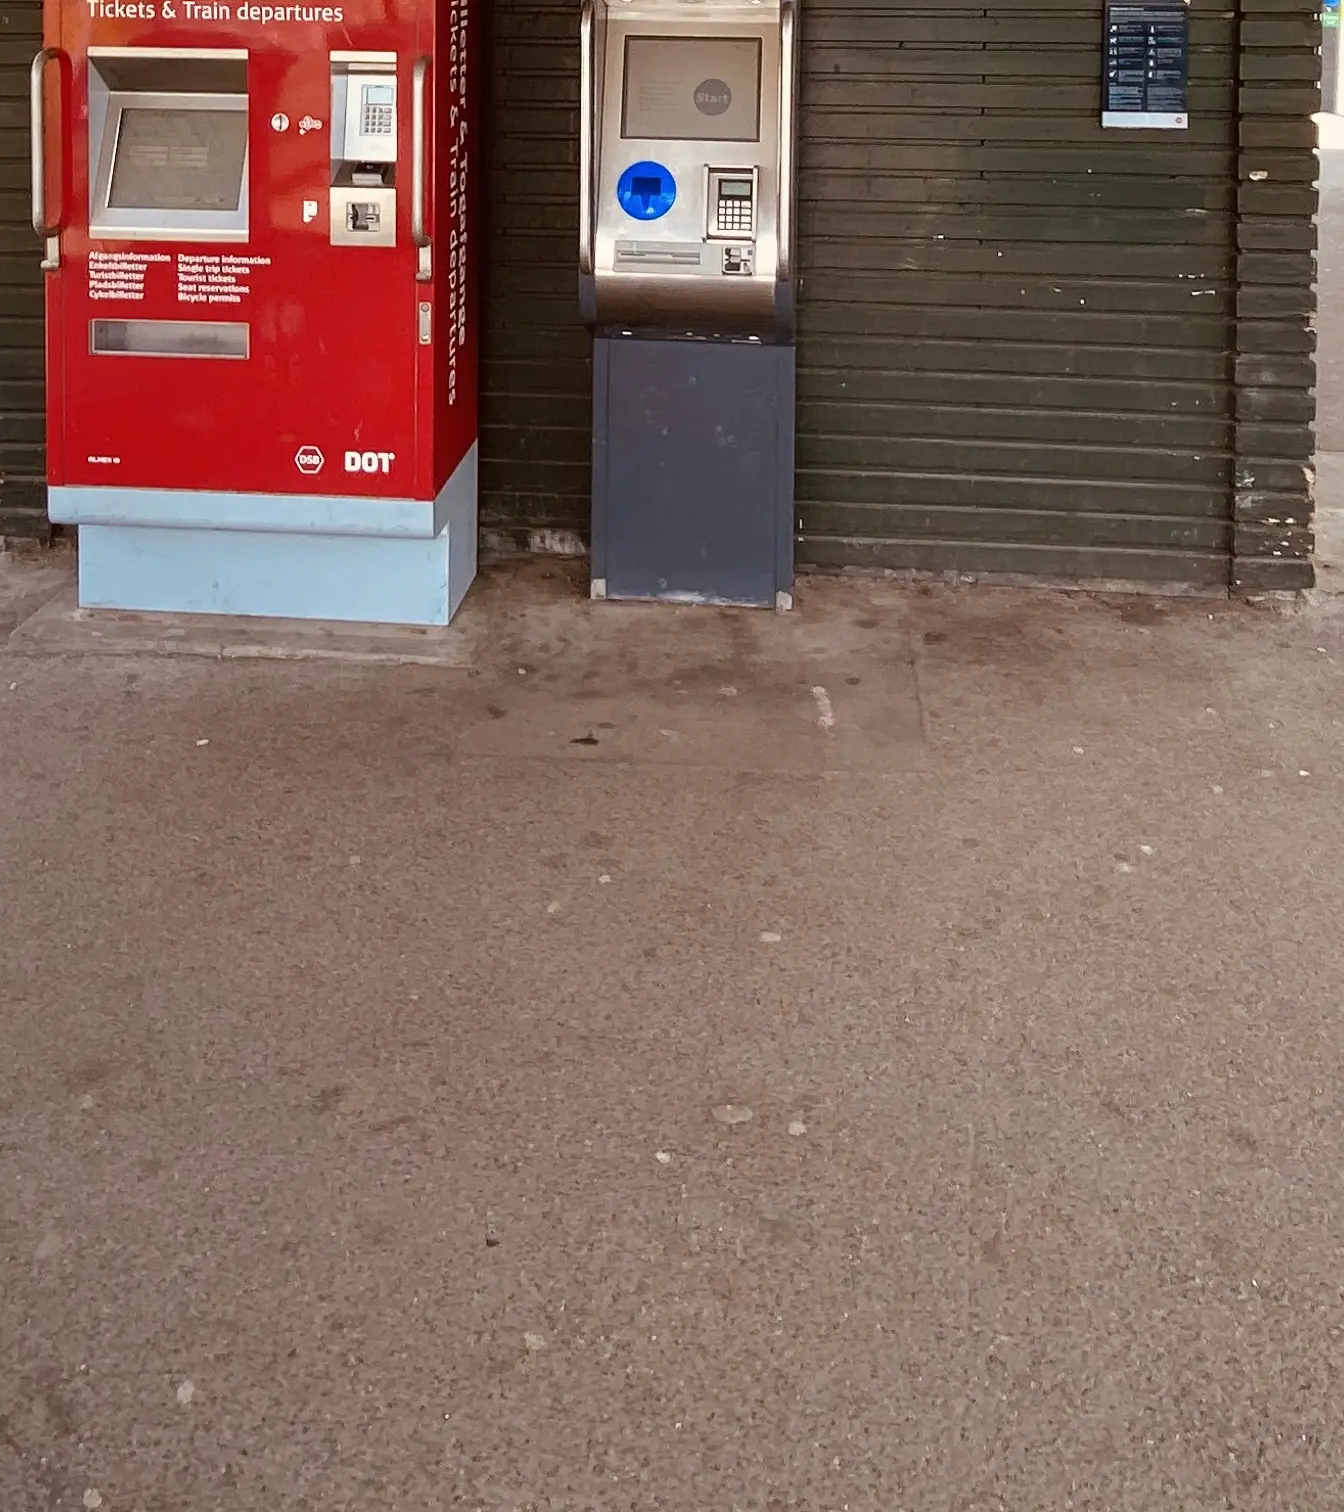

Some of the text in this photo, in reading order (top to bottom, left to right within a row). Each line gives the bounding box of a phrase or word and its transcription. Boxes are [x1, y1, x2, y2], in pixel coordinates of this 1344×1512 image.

[87, 0, 344, 24] Tickets & Train departures
[697, 91, 729, 104] Start
[450, 105, 458, 129] &
[459, 120, 468, 146] &
[450, 137, 459, 218] Train
[177, 253, 220, 265] Departure
[177, 263, 250, 275] Single trip tickets
[177, 273, 236, 284] Tourist tickets
[177, 282, 250, 294] Seat reservations
[177, 292, 241, 304] Bicycle permits
[448, 229, 458, 405] departures
[299, 451, 390, 473] DSB DOT
